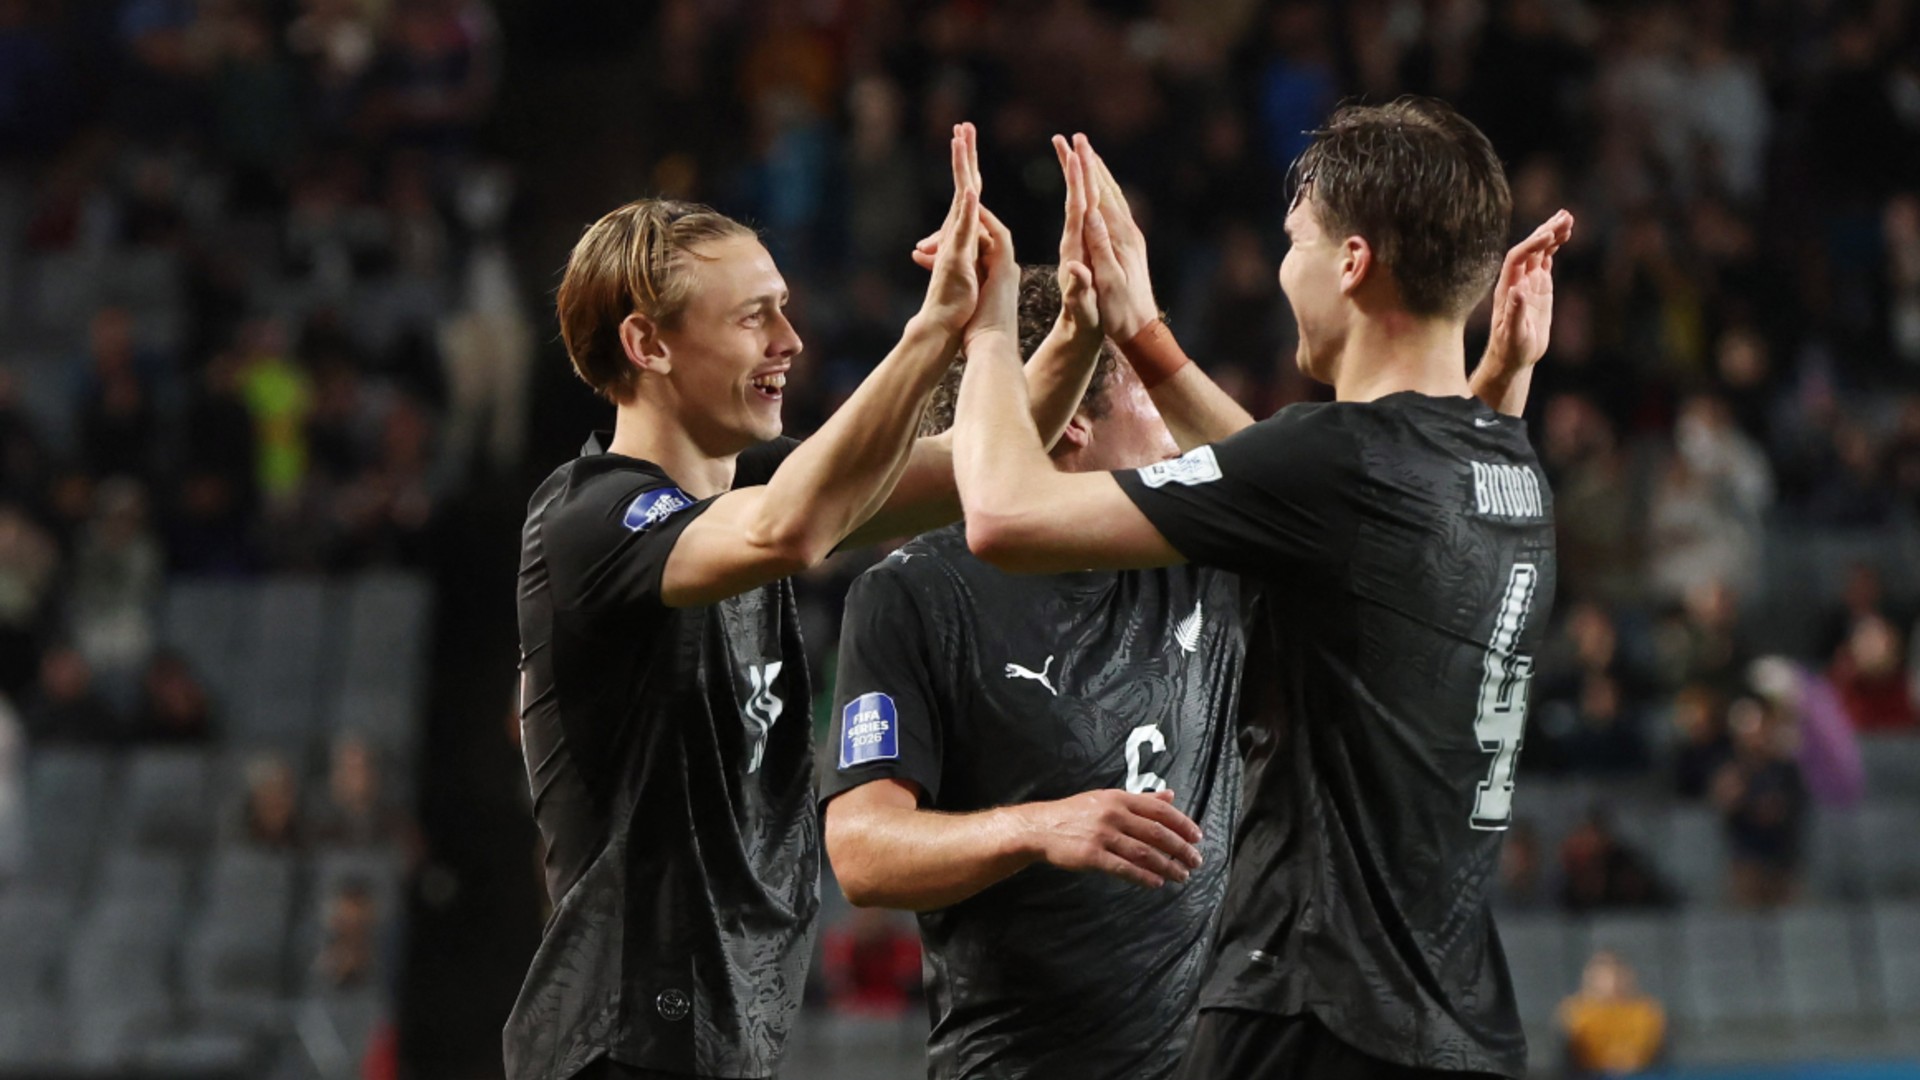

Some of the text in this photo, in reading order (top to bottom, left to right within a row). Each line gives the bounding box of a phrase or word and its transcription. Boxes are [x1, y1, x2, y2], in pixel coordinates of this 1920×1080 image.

[1470, 460, 1543, 517] BINDON
[1469, 563, 1538, 830] 4
[852, 710, 880, 725] FIFA
[847, 720, 889, 739] SERIES
[852, 732, 883, 748] 2026
